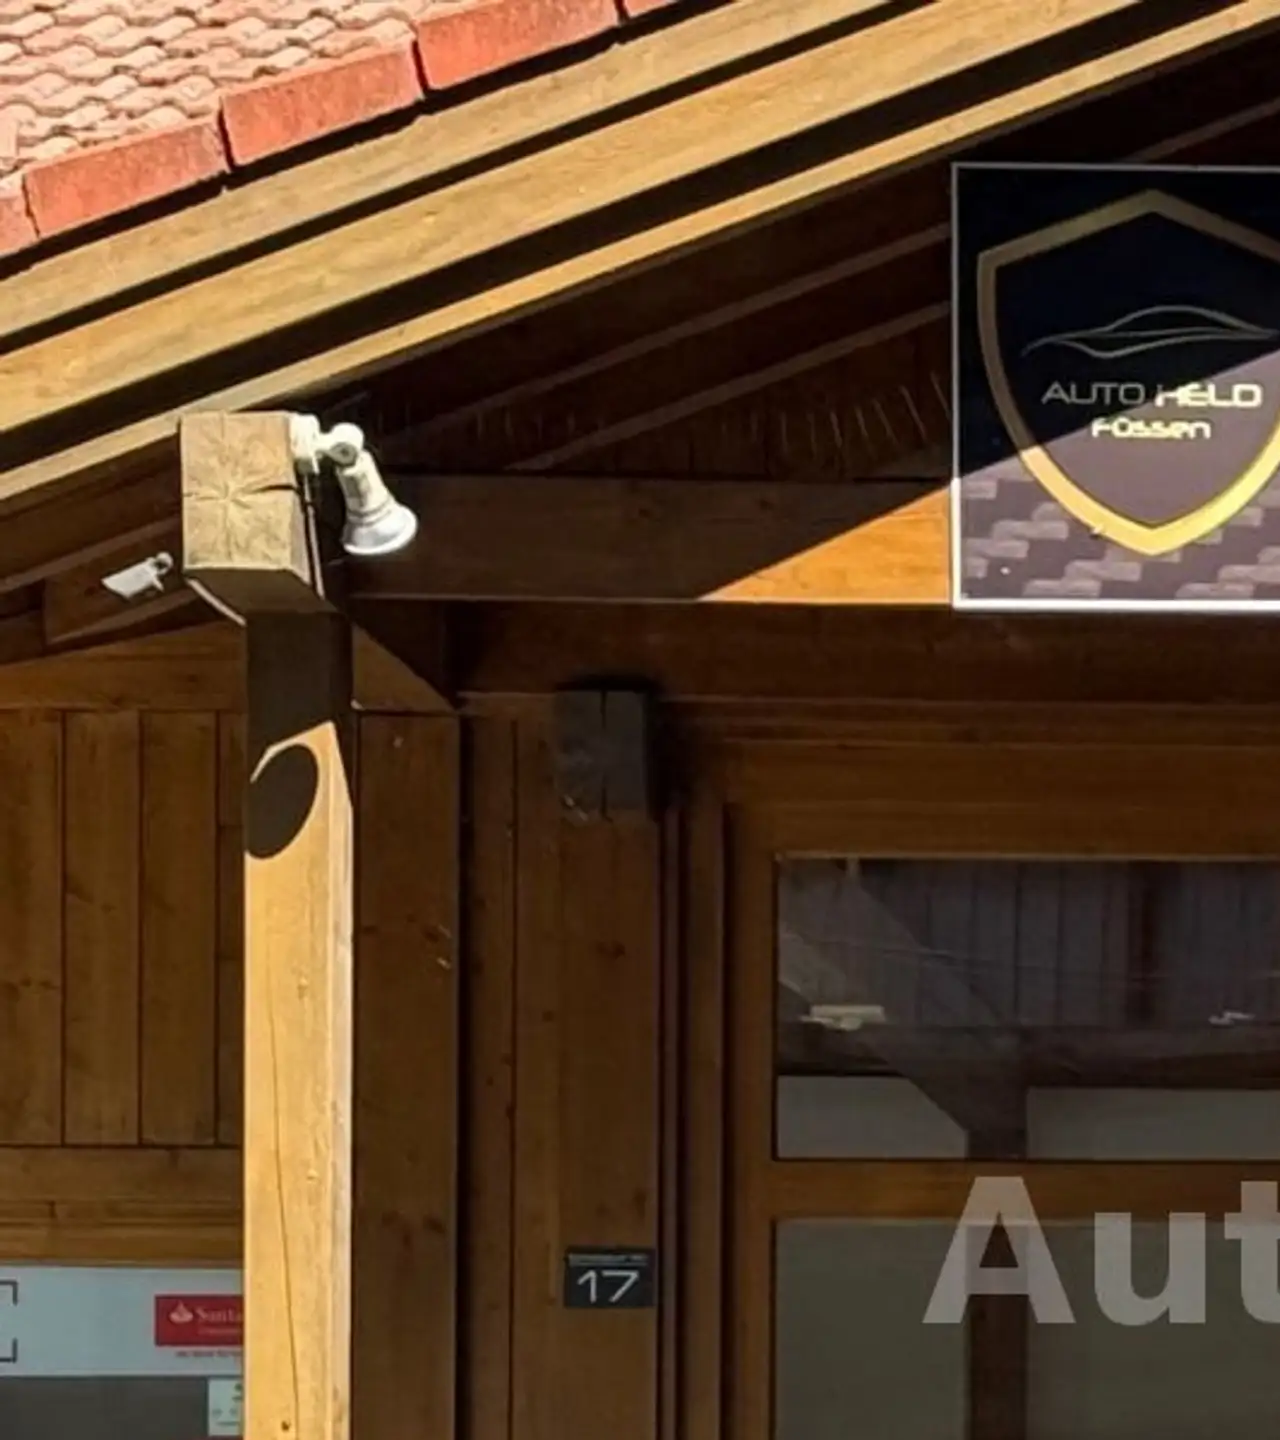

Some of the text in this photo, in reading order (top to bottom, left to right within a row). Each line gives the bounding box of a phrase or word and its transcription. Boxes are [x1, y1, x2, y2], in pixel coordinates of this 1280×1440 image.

[1041, 382, 1262, 407] AUTO HELD
[577, 1269, 639, 1304] 17
